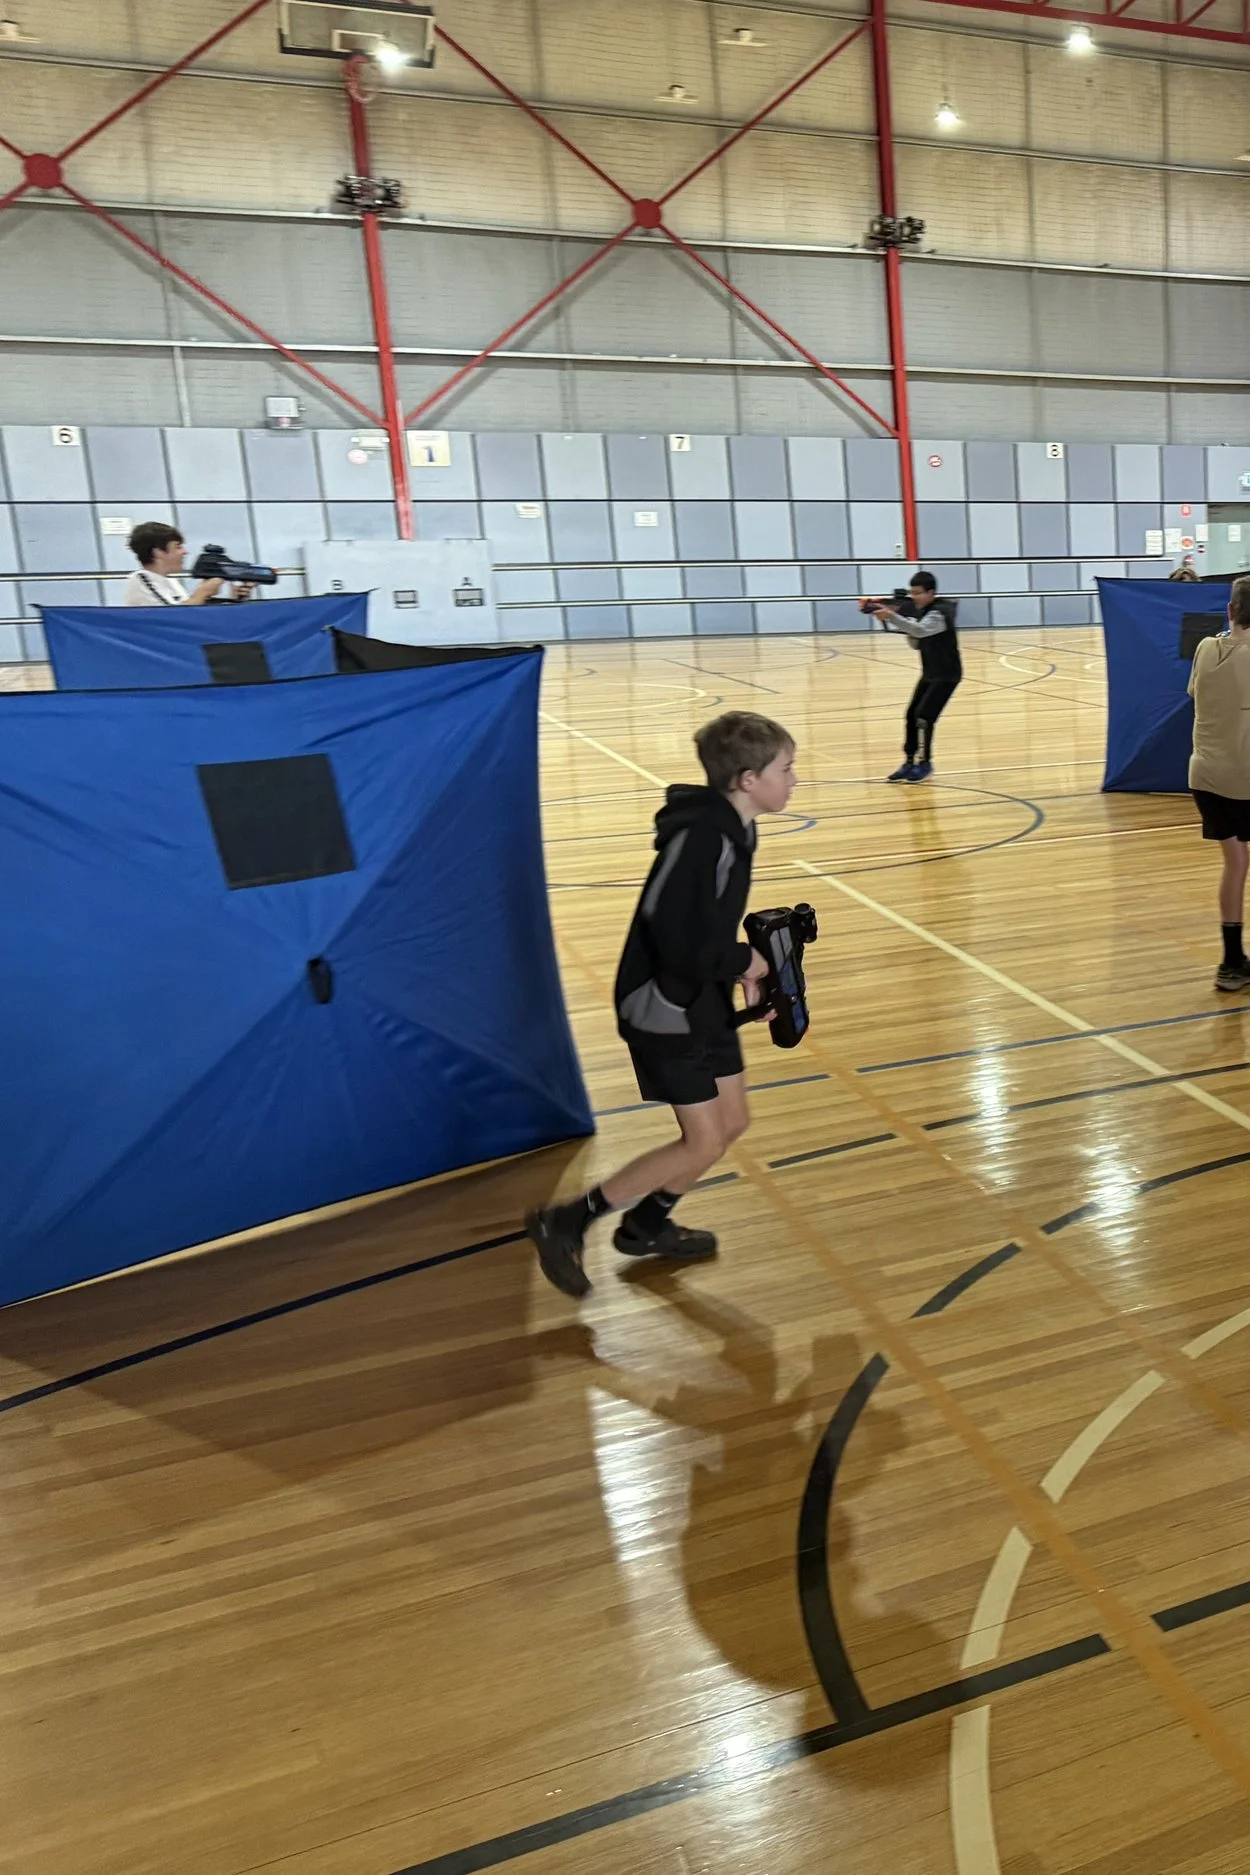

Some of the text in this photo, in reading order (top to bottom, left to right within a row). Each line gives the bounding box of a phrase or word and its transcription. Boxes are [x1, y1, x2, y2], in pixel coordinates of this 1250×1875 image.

[58, 427, 73, 443] 6
[673, 435, 685, 450] 7
[422, 445, 437, 463] 1
[1050, 444, 1061, 457] 8
